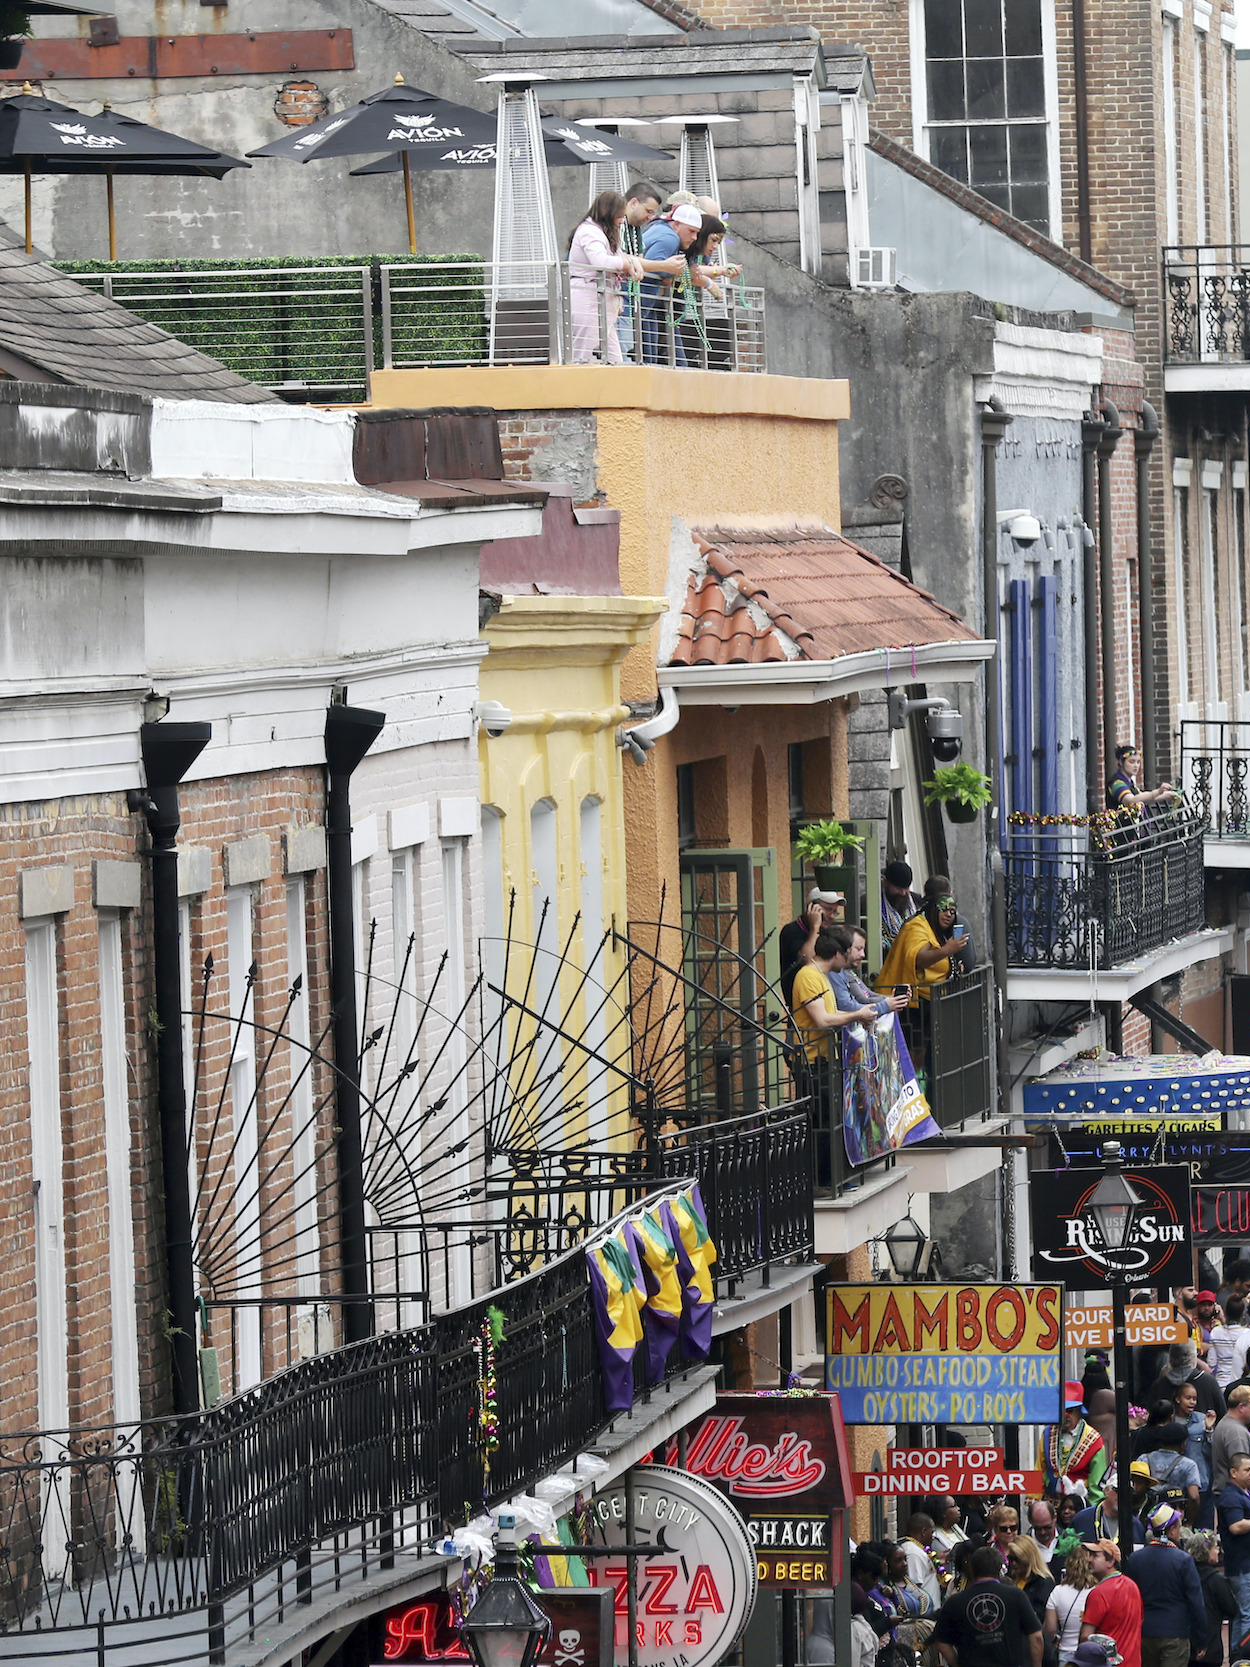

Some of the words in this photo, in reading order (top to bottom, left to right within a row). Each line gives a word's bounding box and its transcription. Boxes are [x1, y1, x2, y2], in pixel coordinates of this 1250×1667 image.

[440, 148, 498, 161] AVIÓ
[1085, 1122, 1153, 1135] GARETTES
[1168, 1121, 1217, 1133] CIGARS
[1096, 1146, 1150, 1158] LRRY
[832, 1286, 1060, 1355] MAMBO'S
[1065, 1329, 1102, 1346] IVE
[892, 1450, 998, 1469] ROOFTOP
[864, 1474, 950, 1493] DINING
[957, 1474, 965, 1492] /
[972, 1473, 1026, 1492] BAR
[655, 1498, 701, 1531] CITY
[748, 1521, 827, 1547] SHACK
[775, 1562, 828, 1582] BEER
